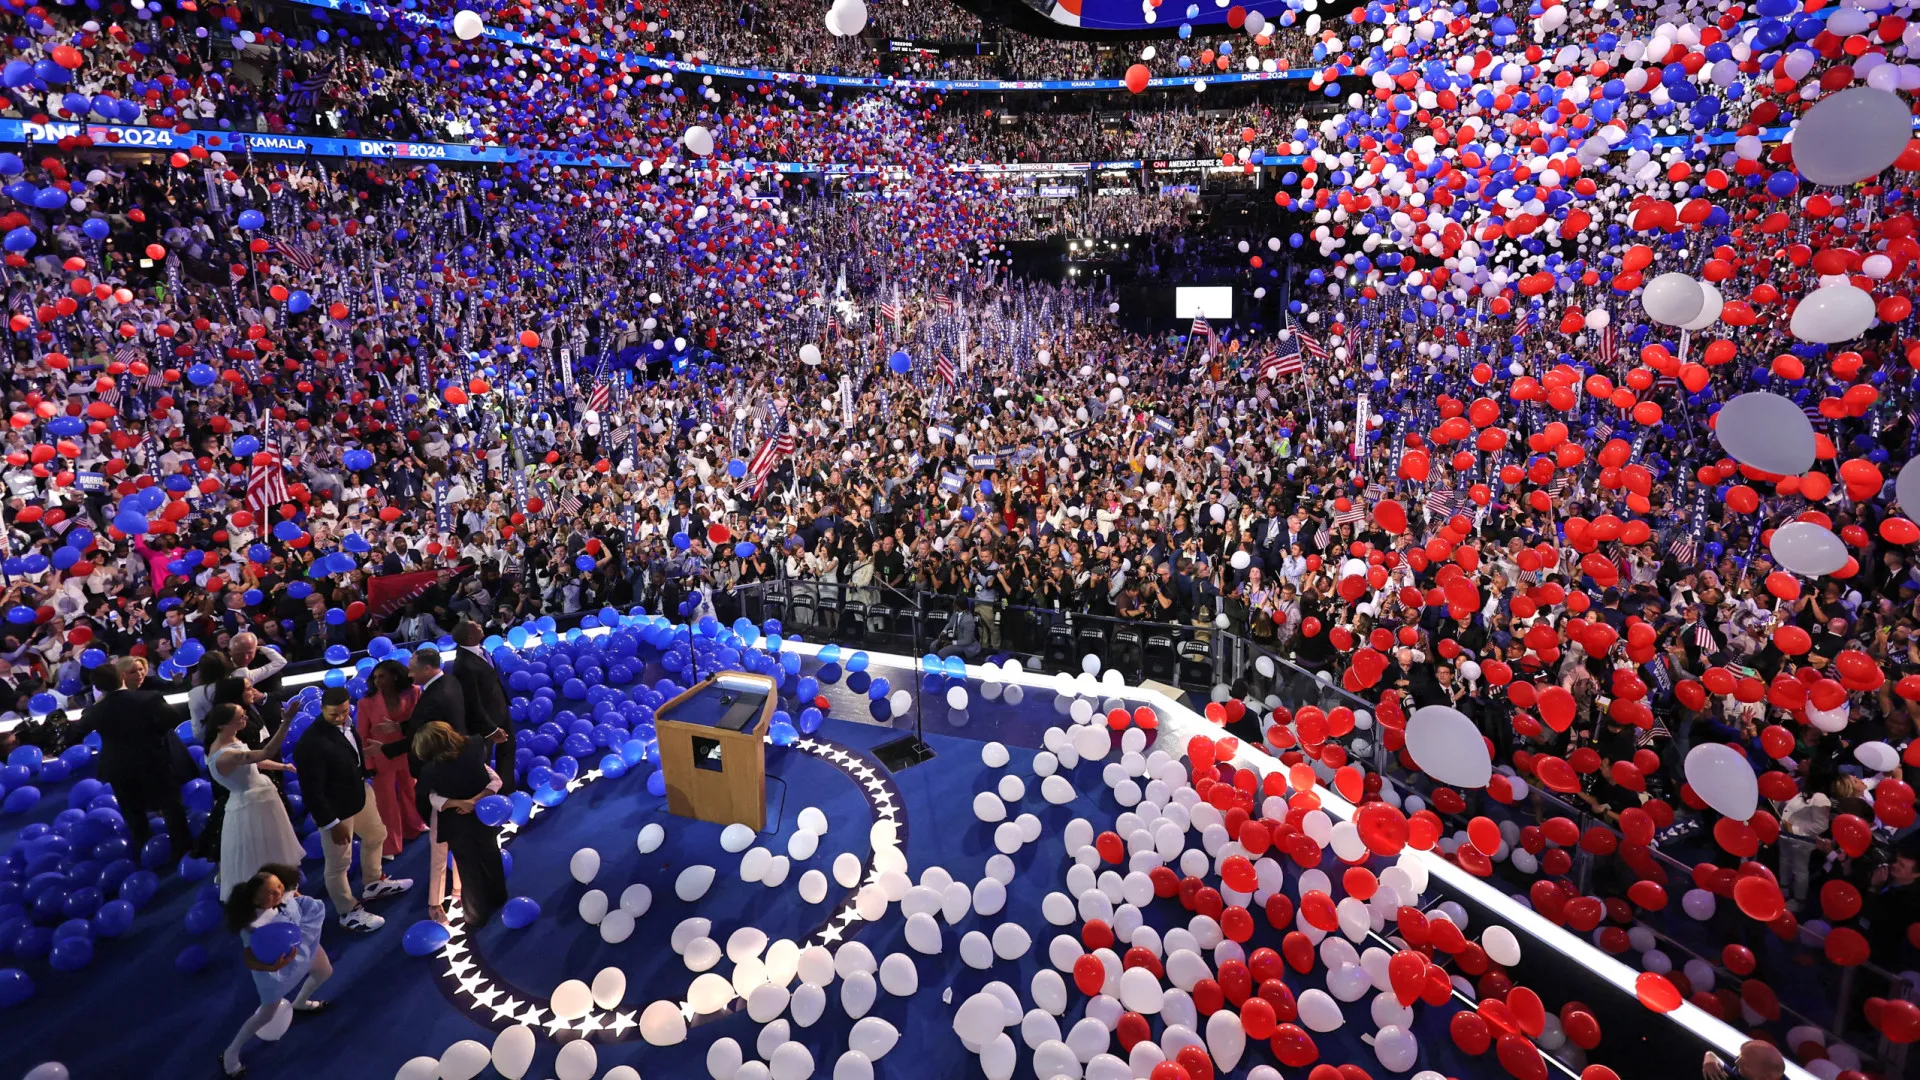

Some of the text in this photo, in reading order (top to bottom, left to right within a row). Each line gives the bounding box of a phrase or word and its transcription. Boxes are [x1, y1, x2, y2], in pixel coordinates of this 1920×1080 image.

[721, 68, 745, 76] KAMALA
[1241, 71, 1288, 81] DNC 2024
[109, 127, 173, 146] 2024
[409, 145, 446, 158] 2024
[1168, 160, 1196, 168] AMERICA'S
[1197, 159, 1215, 167] CHOICE
[169, 267, 178, 291] AMALA
[120, 374, 129, 392] ALA
[247, 359, 258, 381] MALA
[339, 364, 350, 385] MALA
[420, 355, 428, 386] KAMALA
[393, 390, 402, 420] KAMALA
[1589, 398, 1597, 426] AMALA
[601, 415, 610, 447] KAMALA
[938, 425, 954, 438] KAMALA
[1154, 417, 1172, 431] KAMALA
[1396, 416, 1407, 436] KAMA
[1418, 409, 1427, 437] KAMAL
[1872, 410, 1880, 438] KAMA
[517, 430, 534, 459] KAMALA
[627, 437, 635, 470] KAMA
[1390, 439, 1399, 476] KAMALA
[1470, 436, 1478, 476] KAMALA
[1629, 431, 1645, 465] KAMAL
[146, 441, 160, 482] KAMALA
[974, 458, 995, 466] KAMALA
[80, 475, 104, 484] HARRIS
[941, 475, 962, 488] KAMALA
[1490, 458, 1502, 498] KAMALA
[1675, 465, 1686, 506] KAMALA
[438, 486, 447, 527] KAMALA
[515, 474, 529, 514] KAMALA
[1693, 488, 1706, 536] KAMALA
